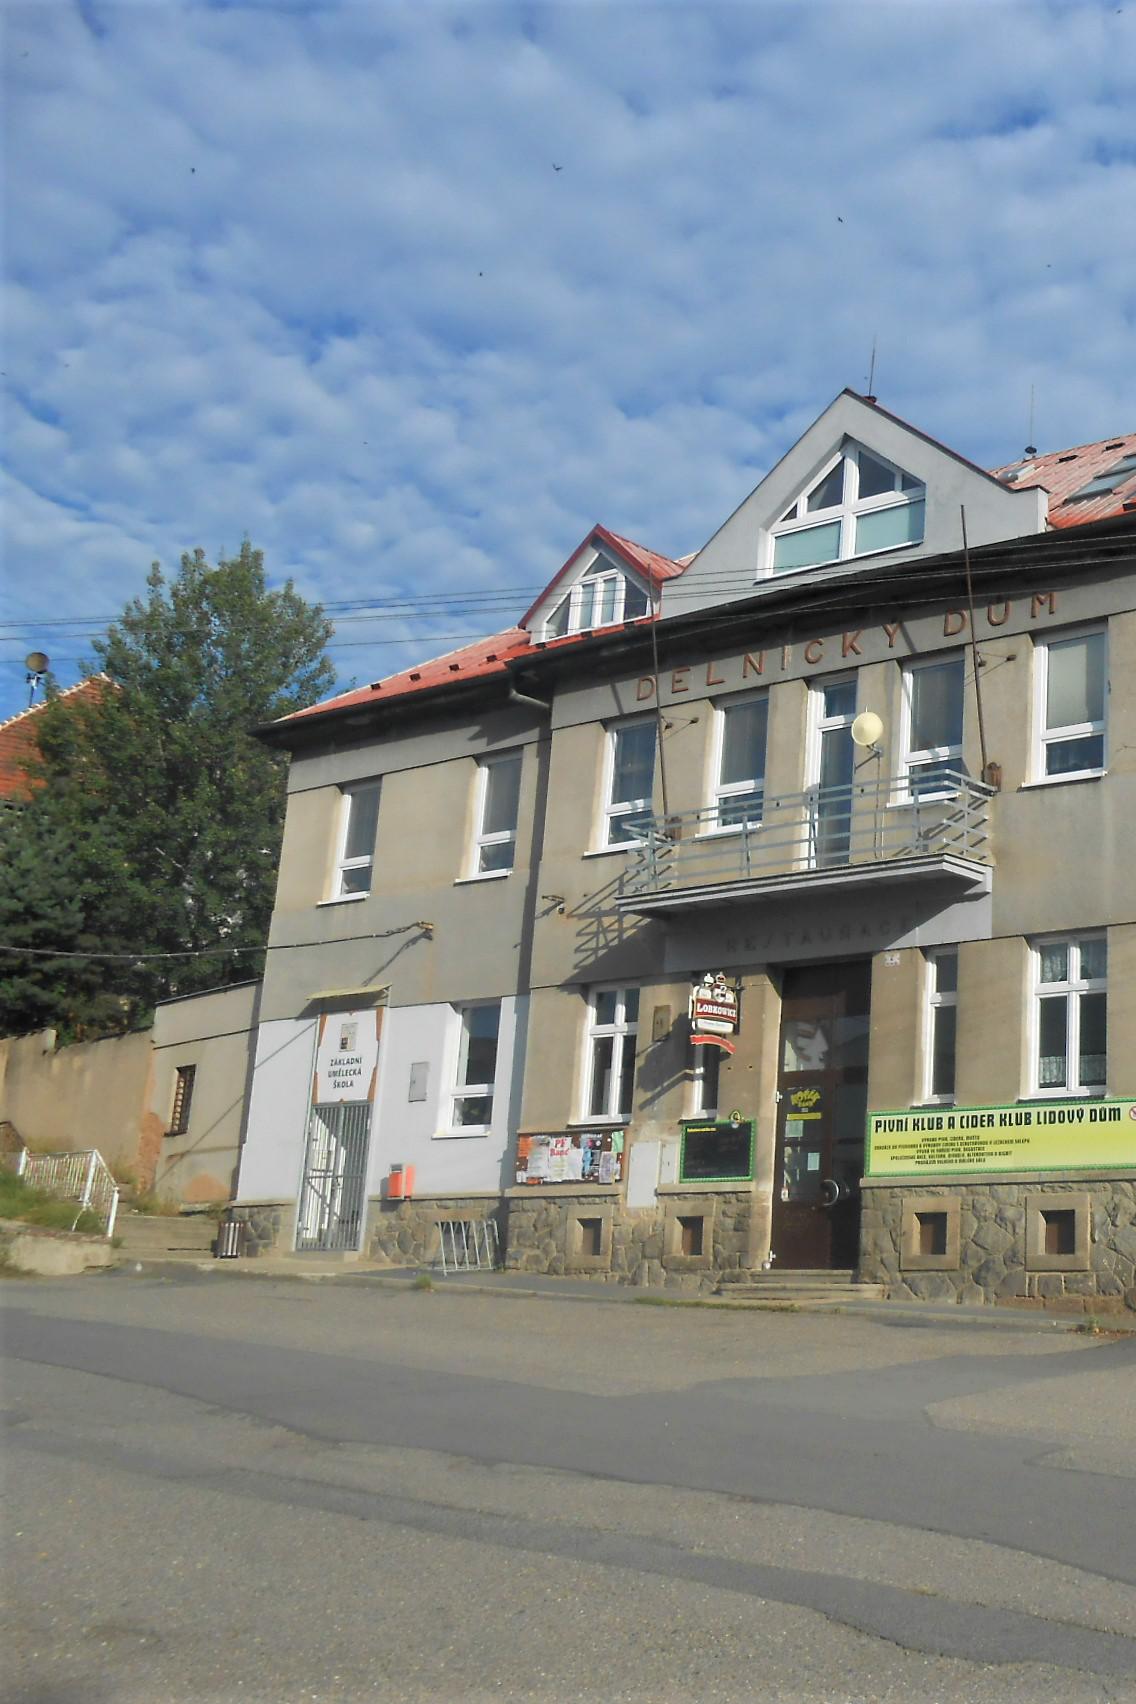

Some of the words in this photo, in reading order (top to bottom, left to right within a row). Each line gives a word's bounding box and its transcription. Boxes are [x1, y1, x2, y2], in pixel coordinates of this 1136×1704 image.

[875, 1118, 908, 1133] PIVNÍ
[912, 1117, 943, 1131] KLUB
[947, 1116, 955, 1129] A
[960, 1114, 995, 1129] CIDER
[999, 1112, 1032, 1127] KLUB
[1036, 1107, 1085, 1125] LIDOVÝ
